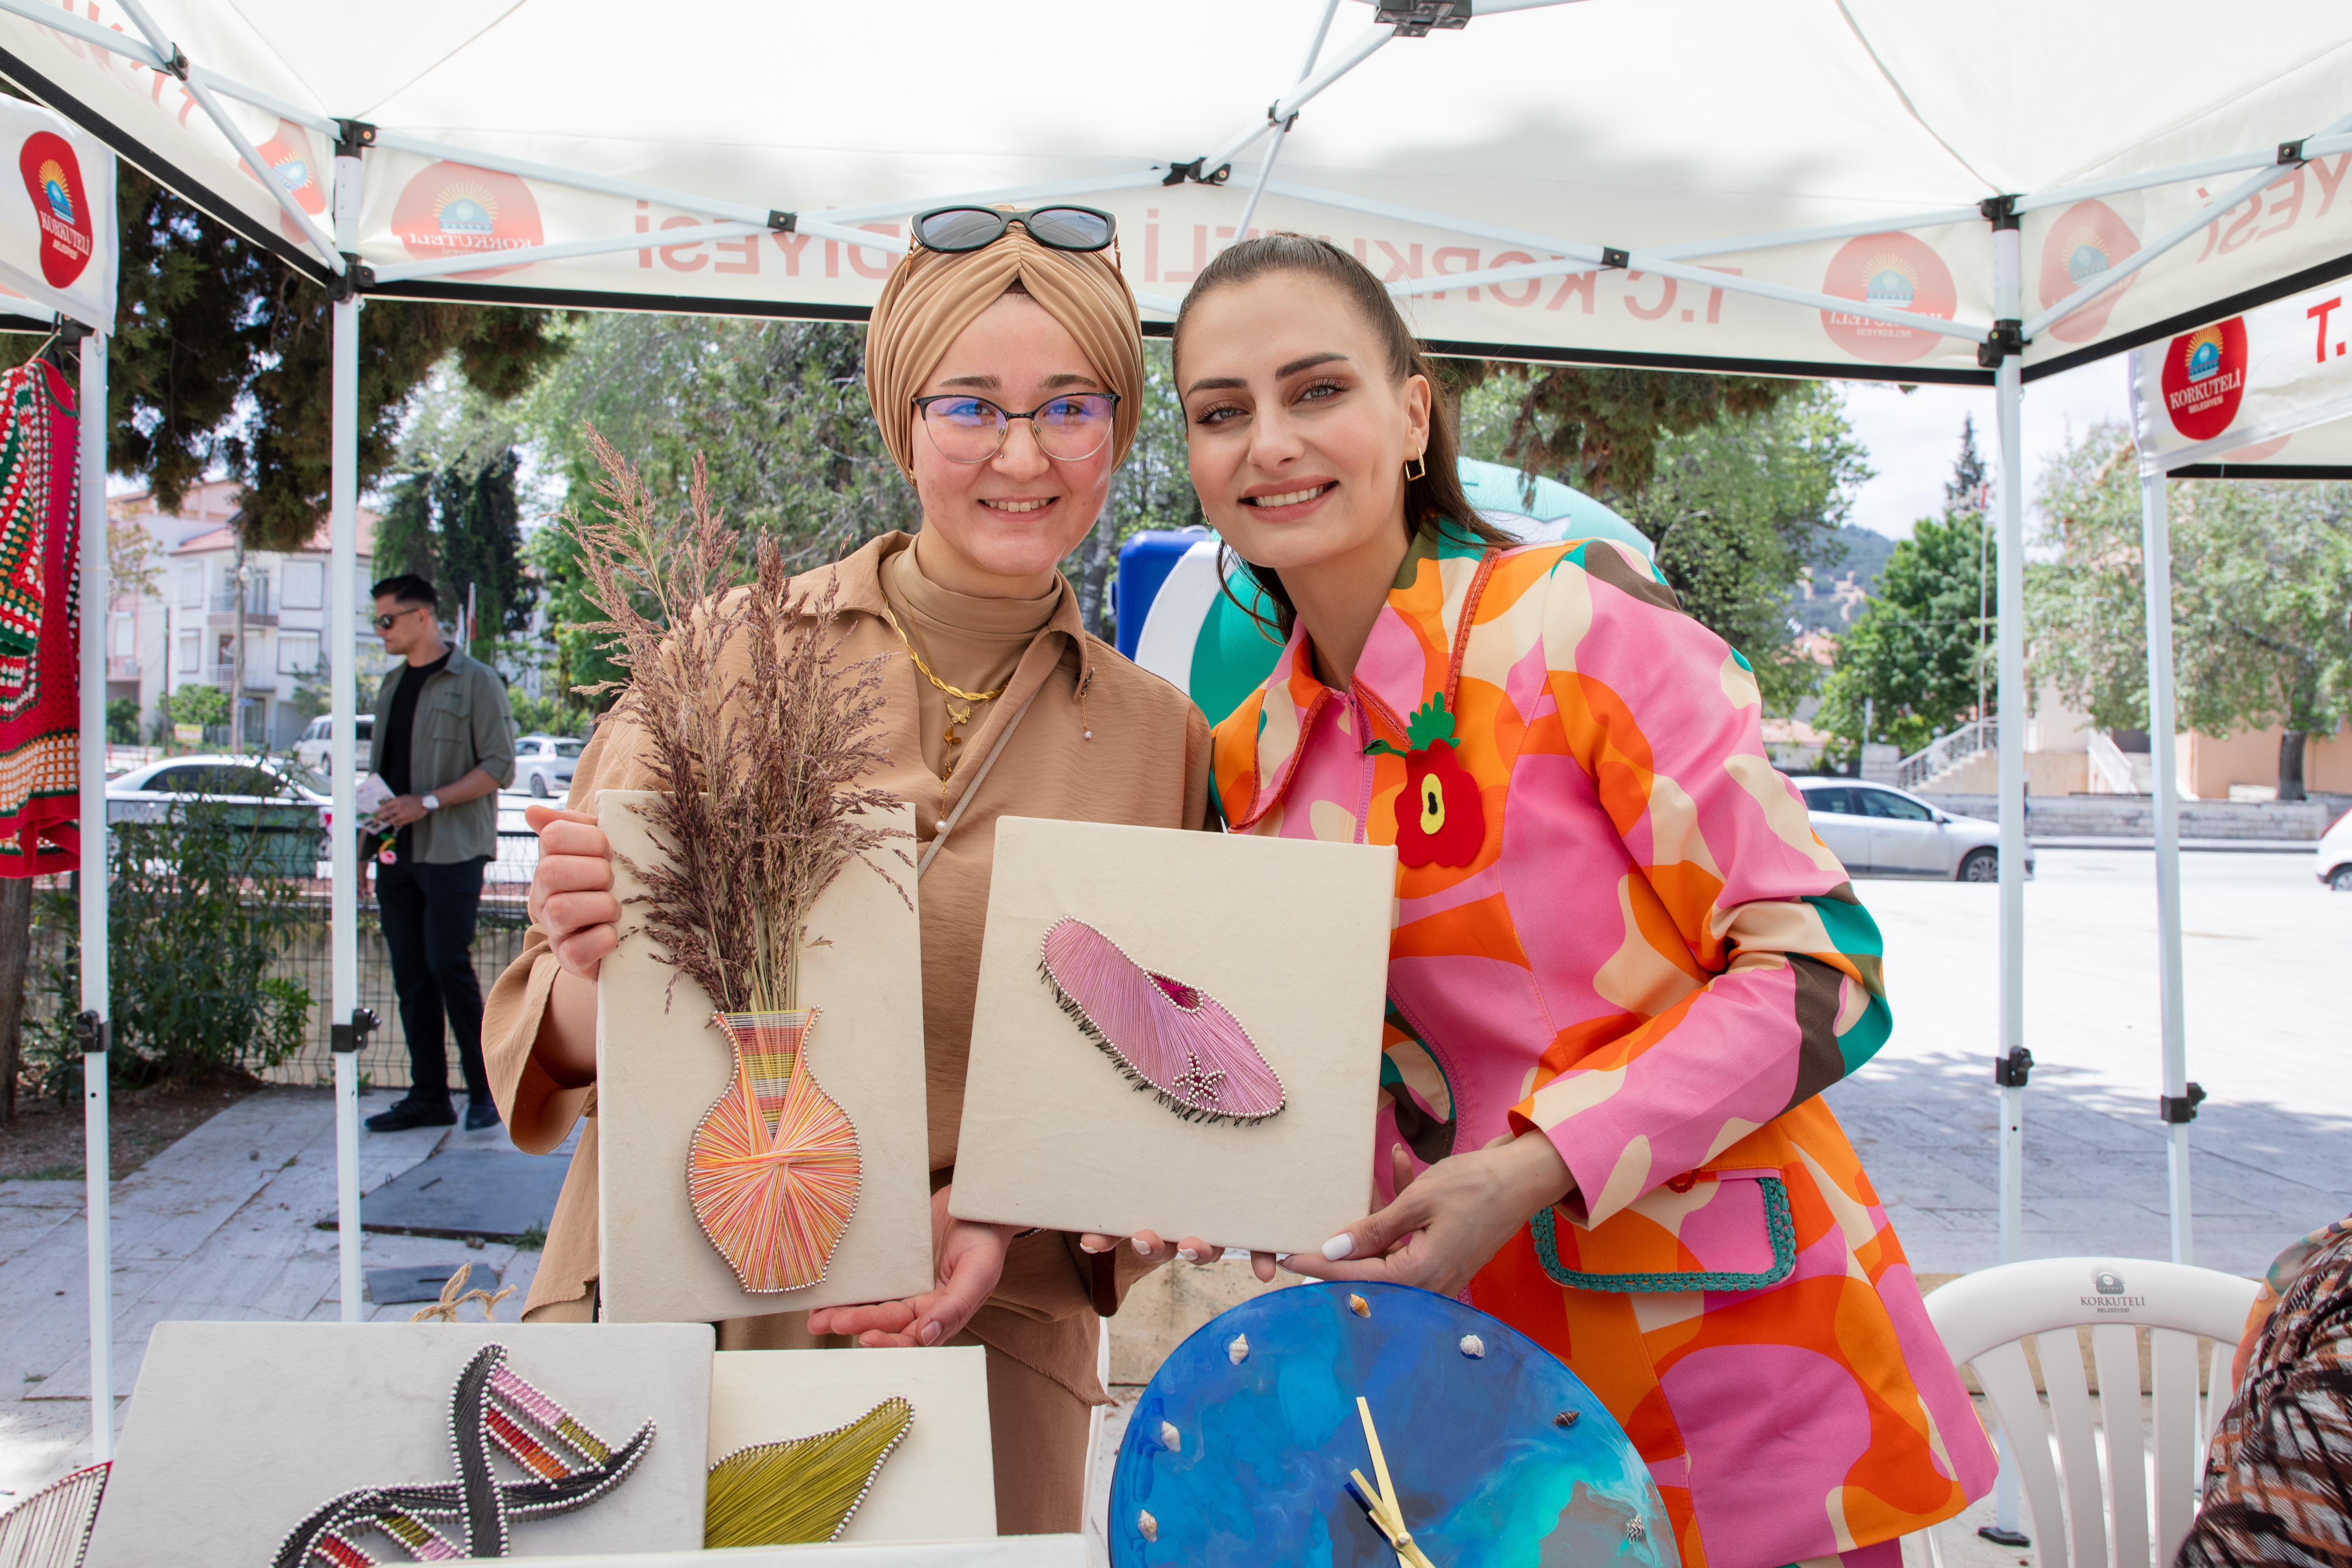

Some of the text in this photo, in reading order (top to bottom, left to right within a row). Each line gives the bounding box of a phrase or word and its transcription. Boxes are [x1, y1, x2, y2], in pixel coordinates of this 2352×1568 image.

[39, 209, 90, 257] KORKUTELİ
[2169, 367, 2241, 410] KORKUTELİ
[2080, 1294, 2145, 1306] KORKUTELİ
